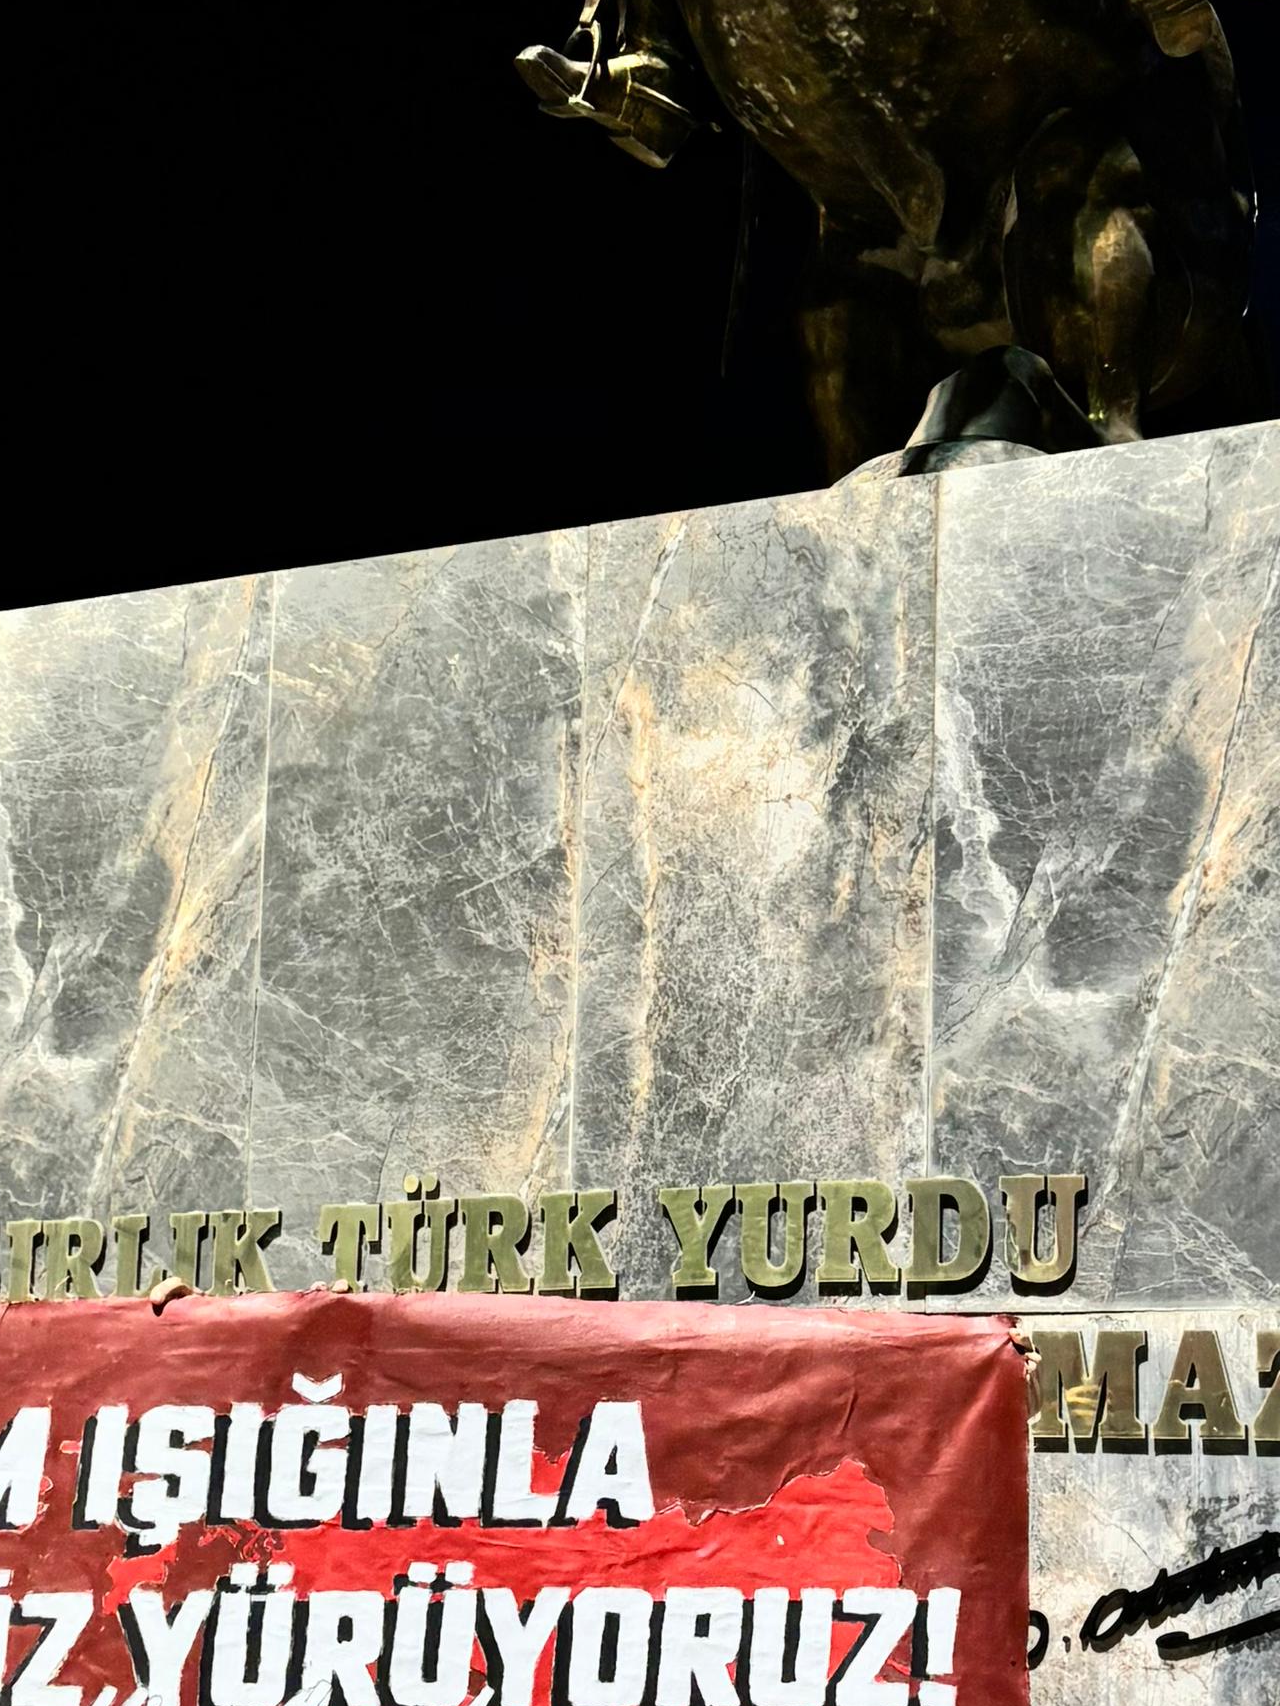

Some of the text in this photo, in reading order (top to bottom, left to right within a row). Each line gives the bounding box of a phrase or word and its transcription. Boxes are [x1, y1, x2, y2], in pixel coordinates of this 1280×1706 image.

[322, 1174, 619, 1293] TÜRK
[659, 1174, 1086, 1295] YURDU
[72, 1371, 656, 1559] IŞIĞINLA
